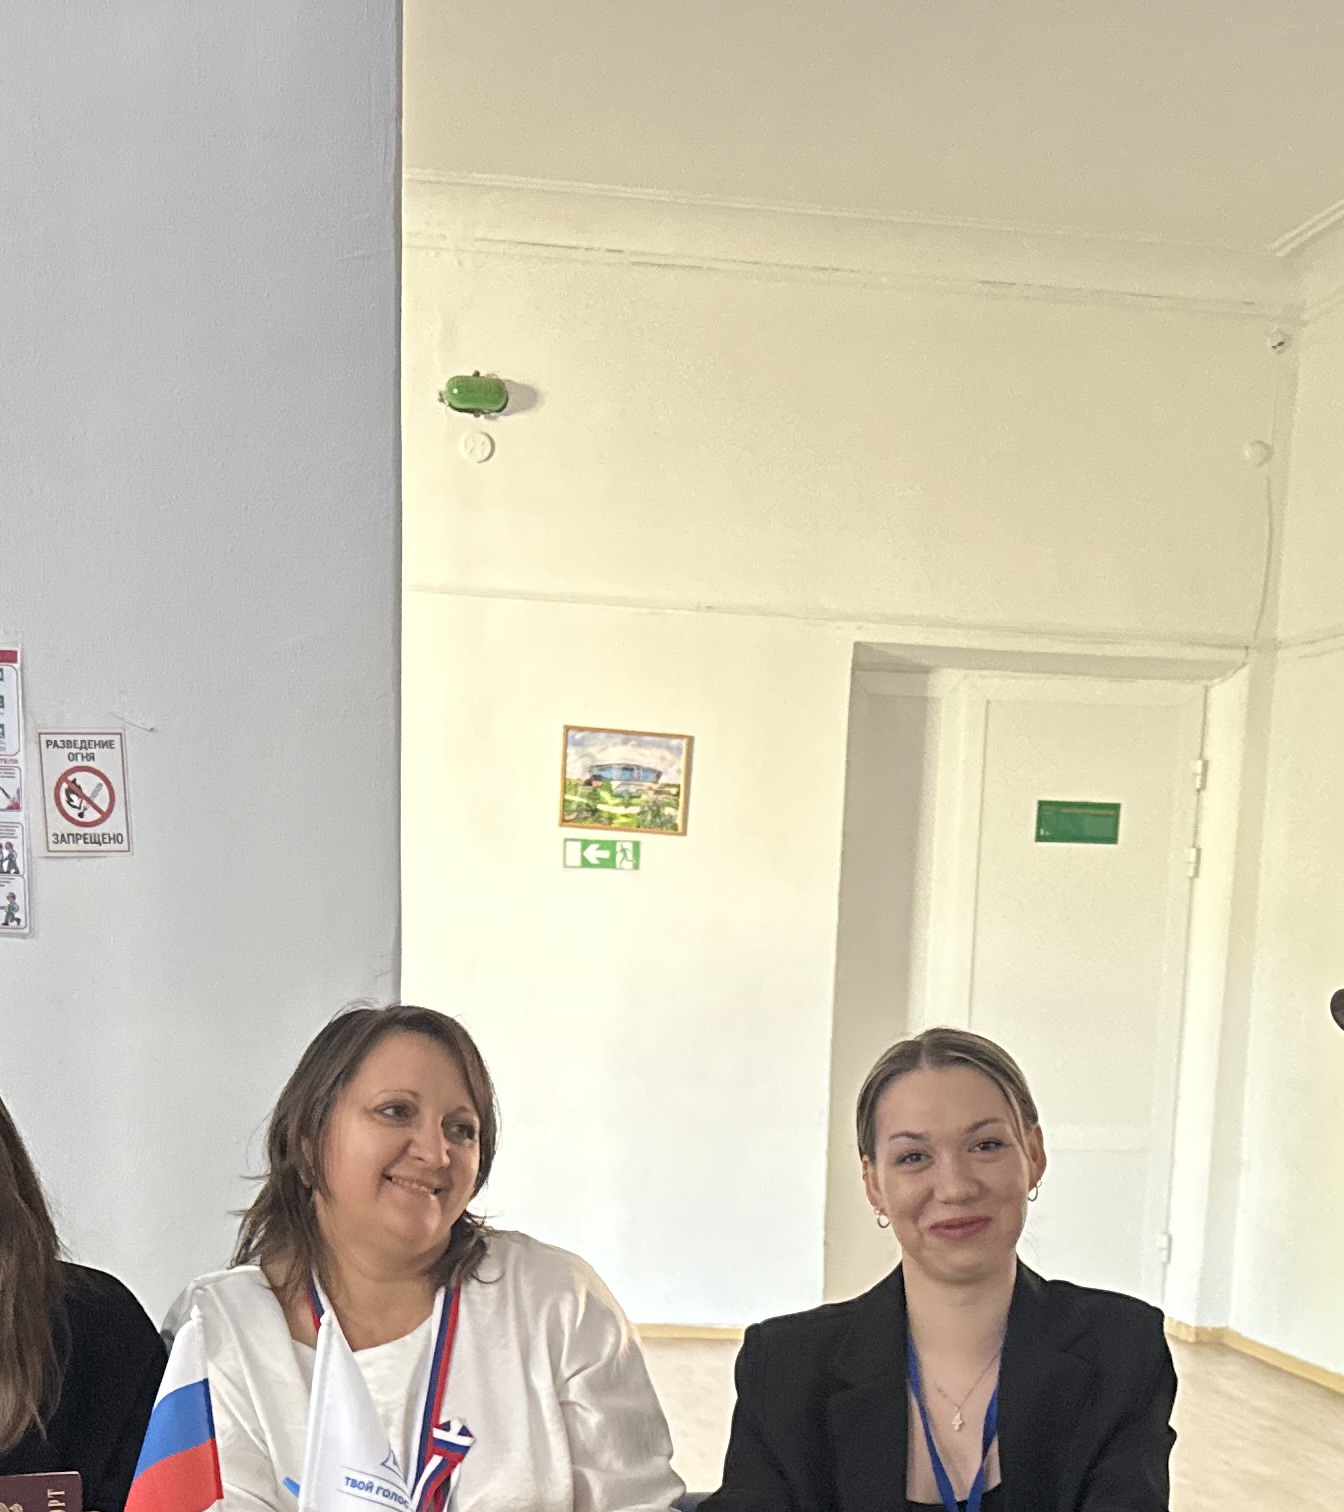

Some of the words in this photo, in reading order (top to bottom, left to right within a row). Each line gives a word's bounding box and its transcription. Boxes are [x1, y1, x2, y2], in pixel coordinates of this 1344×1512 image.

[45, 739, 116, 750] РАЗВЕДЕНИЕ
[67, 752, 95, 762] ОГНЯ
[52, 832, 124, 846] ЗАПРЕЩЕНО
[345, 1476, 374, 1493] ТВОЙ
